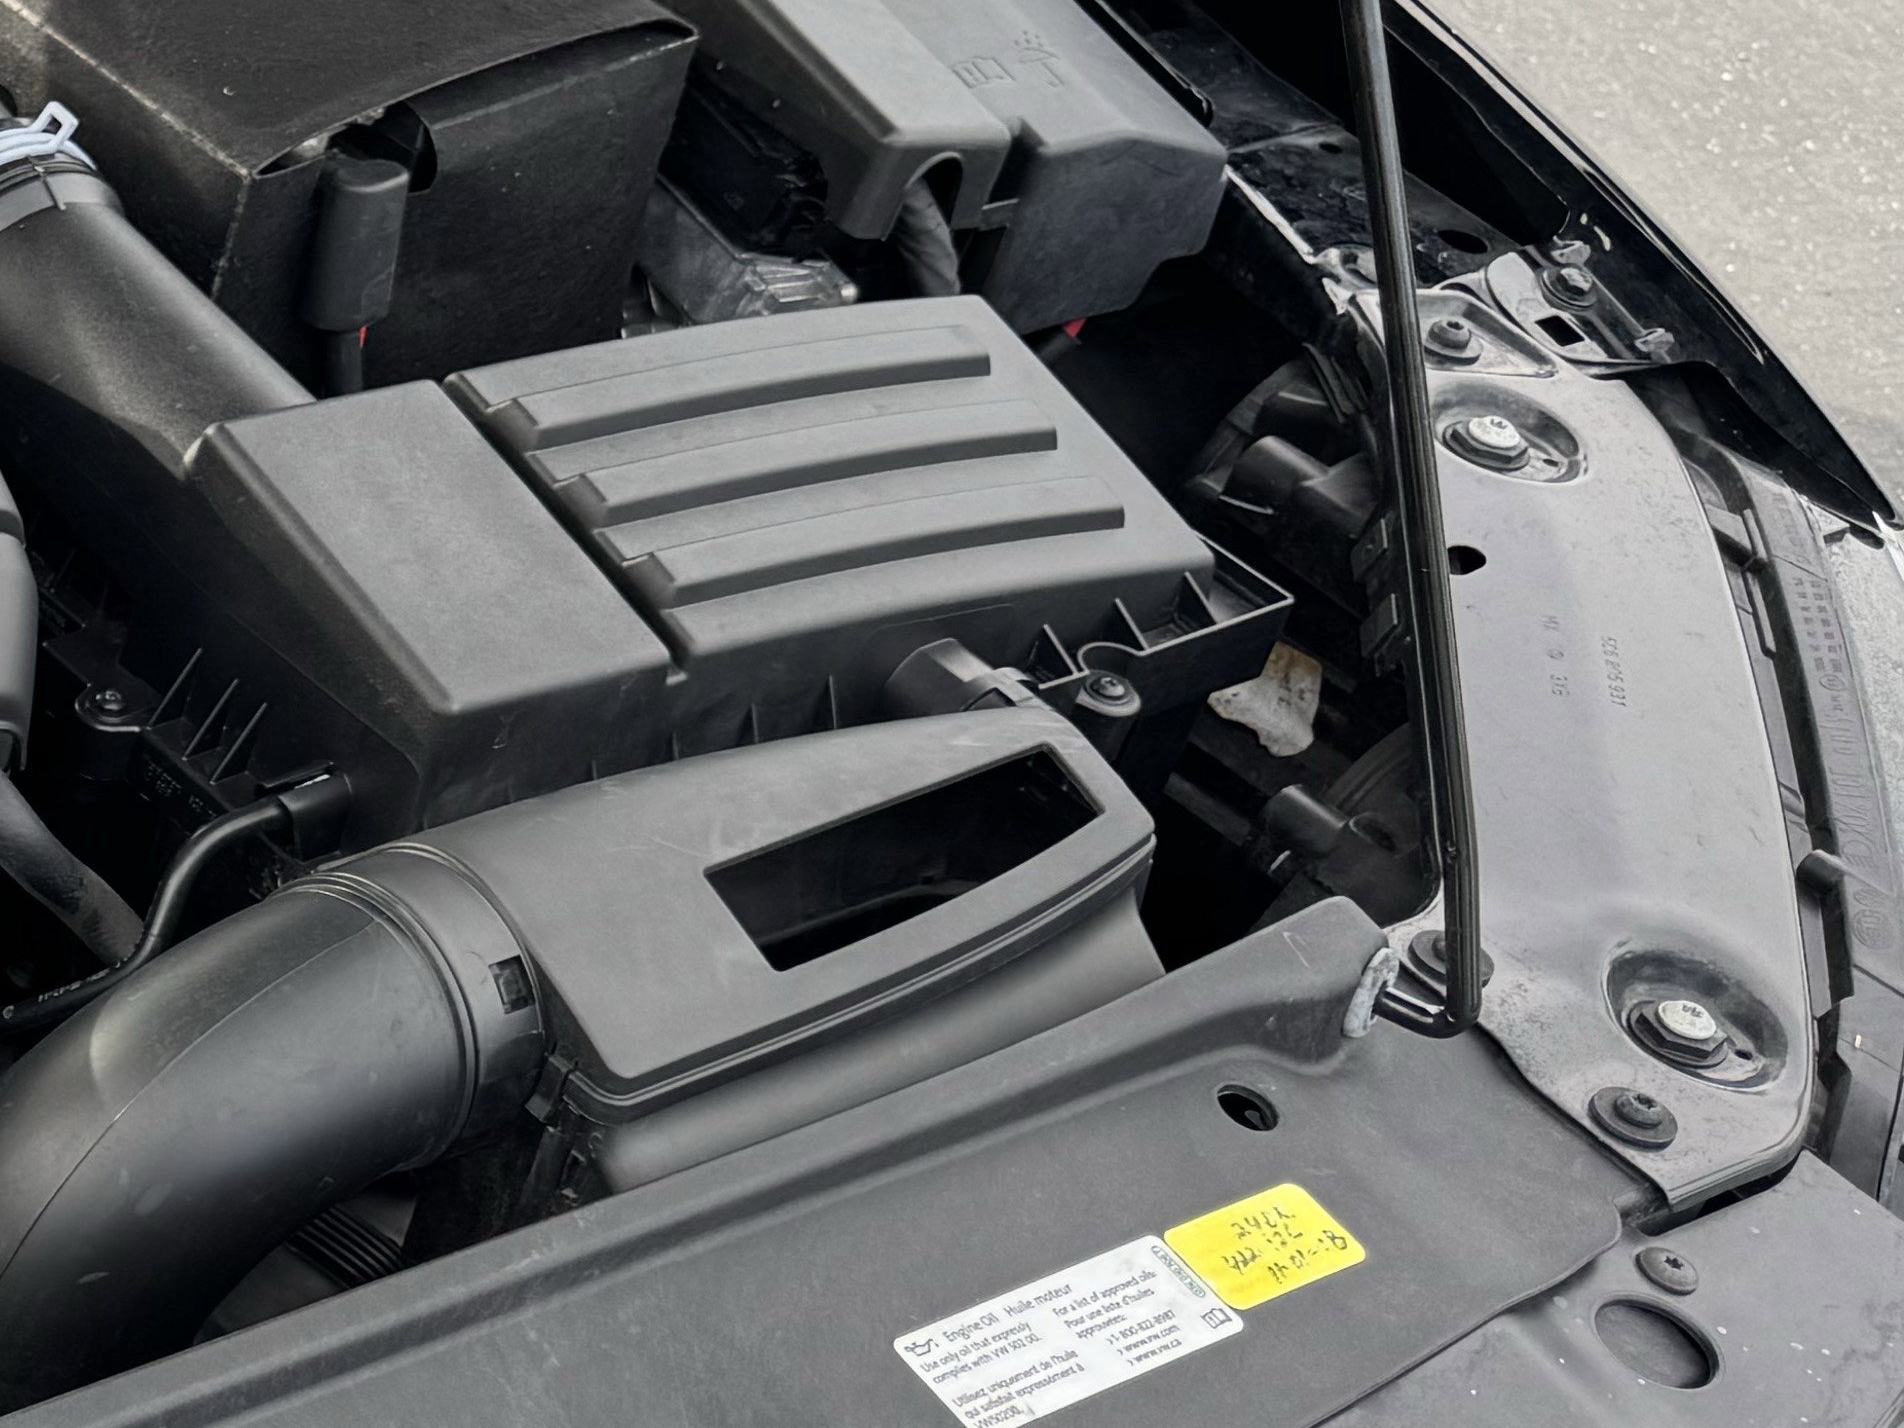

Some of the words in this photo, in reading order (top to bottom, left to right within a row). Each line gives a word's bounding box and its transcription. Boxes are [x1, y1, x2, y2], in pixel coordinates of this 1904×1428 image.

[942, 1322, 983, 1342] Engine
[979, 1312, 1000, 1327] Oil
[1003, 1300, 1035, 1317] Huile
[1033, 1284, 1072, 1305] moteur
[1052, 1306, 1069, 1316] For
[1073, 1297, 1091, 1308] list
[1089, 1291, 1100, 1303] of
[1100, 1276, 1140, 1298] approved
[1063, 1315, 1086, 1329] Pour
[1086, 1309, 1104, 1321] une
[1101, 1301, 1122, 1313] liste
[920, 1360, 940, 1373] Use
[939, 1351, 961, 1366] only
[958, 1344, 973, 1357] oil
[970, 1337, 992, 1351] that
[991, 1322, 1032, 1343] expressly
[932, 1363, 972, 1384] complies
[971, 1353, 993, 1368] with
[991, 1345, 1010, 1358] VW
[1007, 1338, 1027, 1351] 502
[952, 1388, 989, 1408] Utilisez
[987, 1365, 1040, 1393] uniquement
[1039, 1361, 1053, 1371] de
[1050, 1350, 1079, 1365] l'huile
[964, 1407, 981, 1419] qui
[980, 1391, 1016, 1412] satisfait
